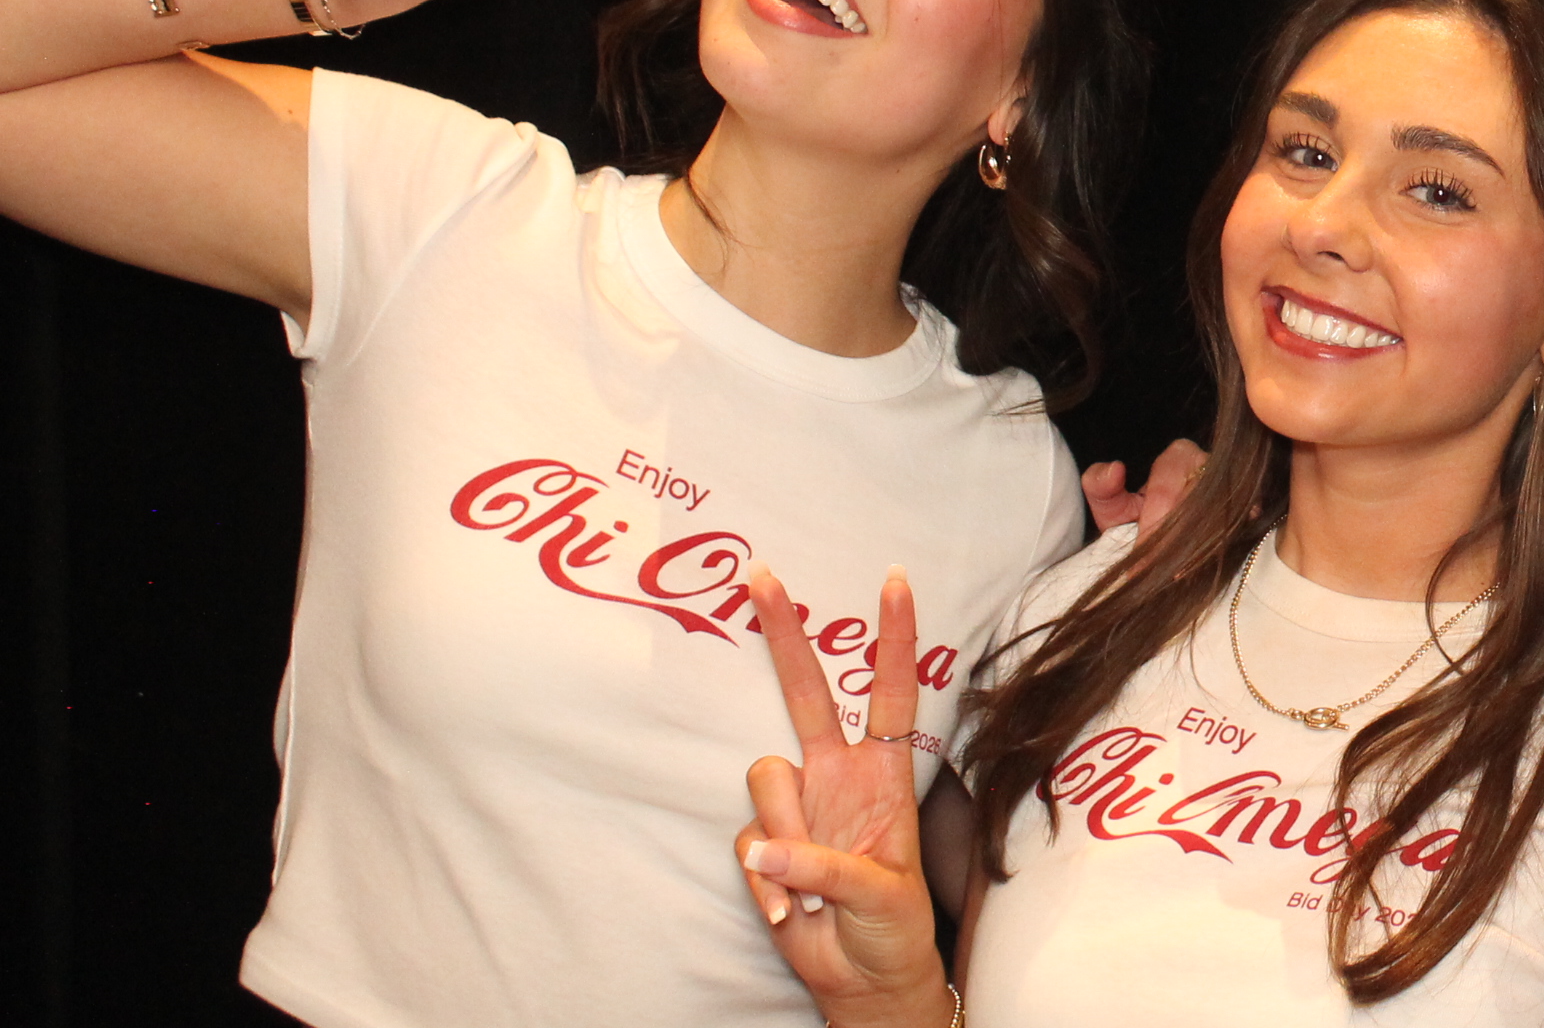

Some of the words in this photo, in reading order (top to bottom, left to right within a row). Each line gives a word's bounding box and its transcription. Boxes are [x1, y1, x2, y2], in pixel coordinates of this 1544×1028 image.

[615, 448, 710, 511] Enjoy
[1176, 707, 1258, 754] Enjoy
[1286, 892, 1323, 911] Bid
[1326, 897, 1370, 921] Dy
[1375, 906, 1419, 927] 20
